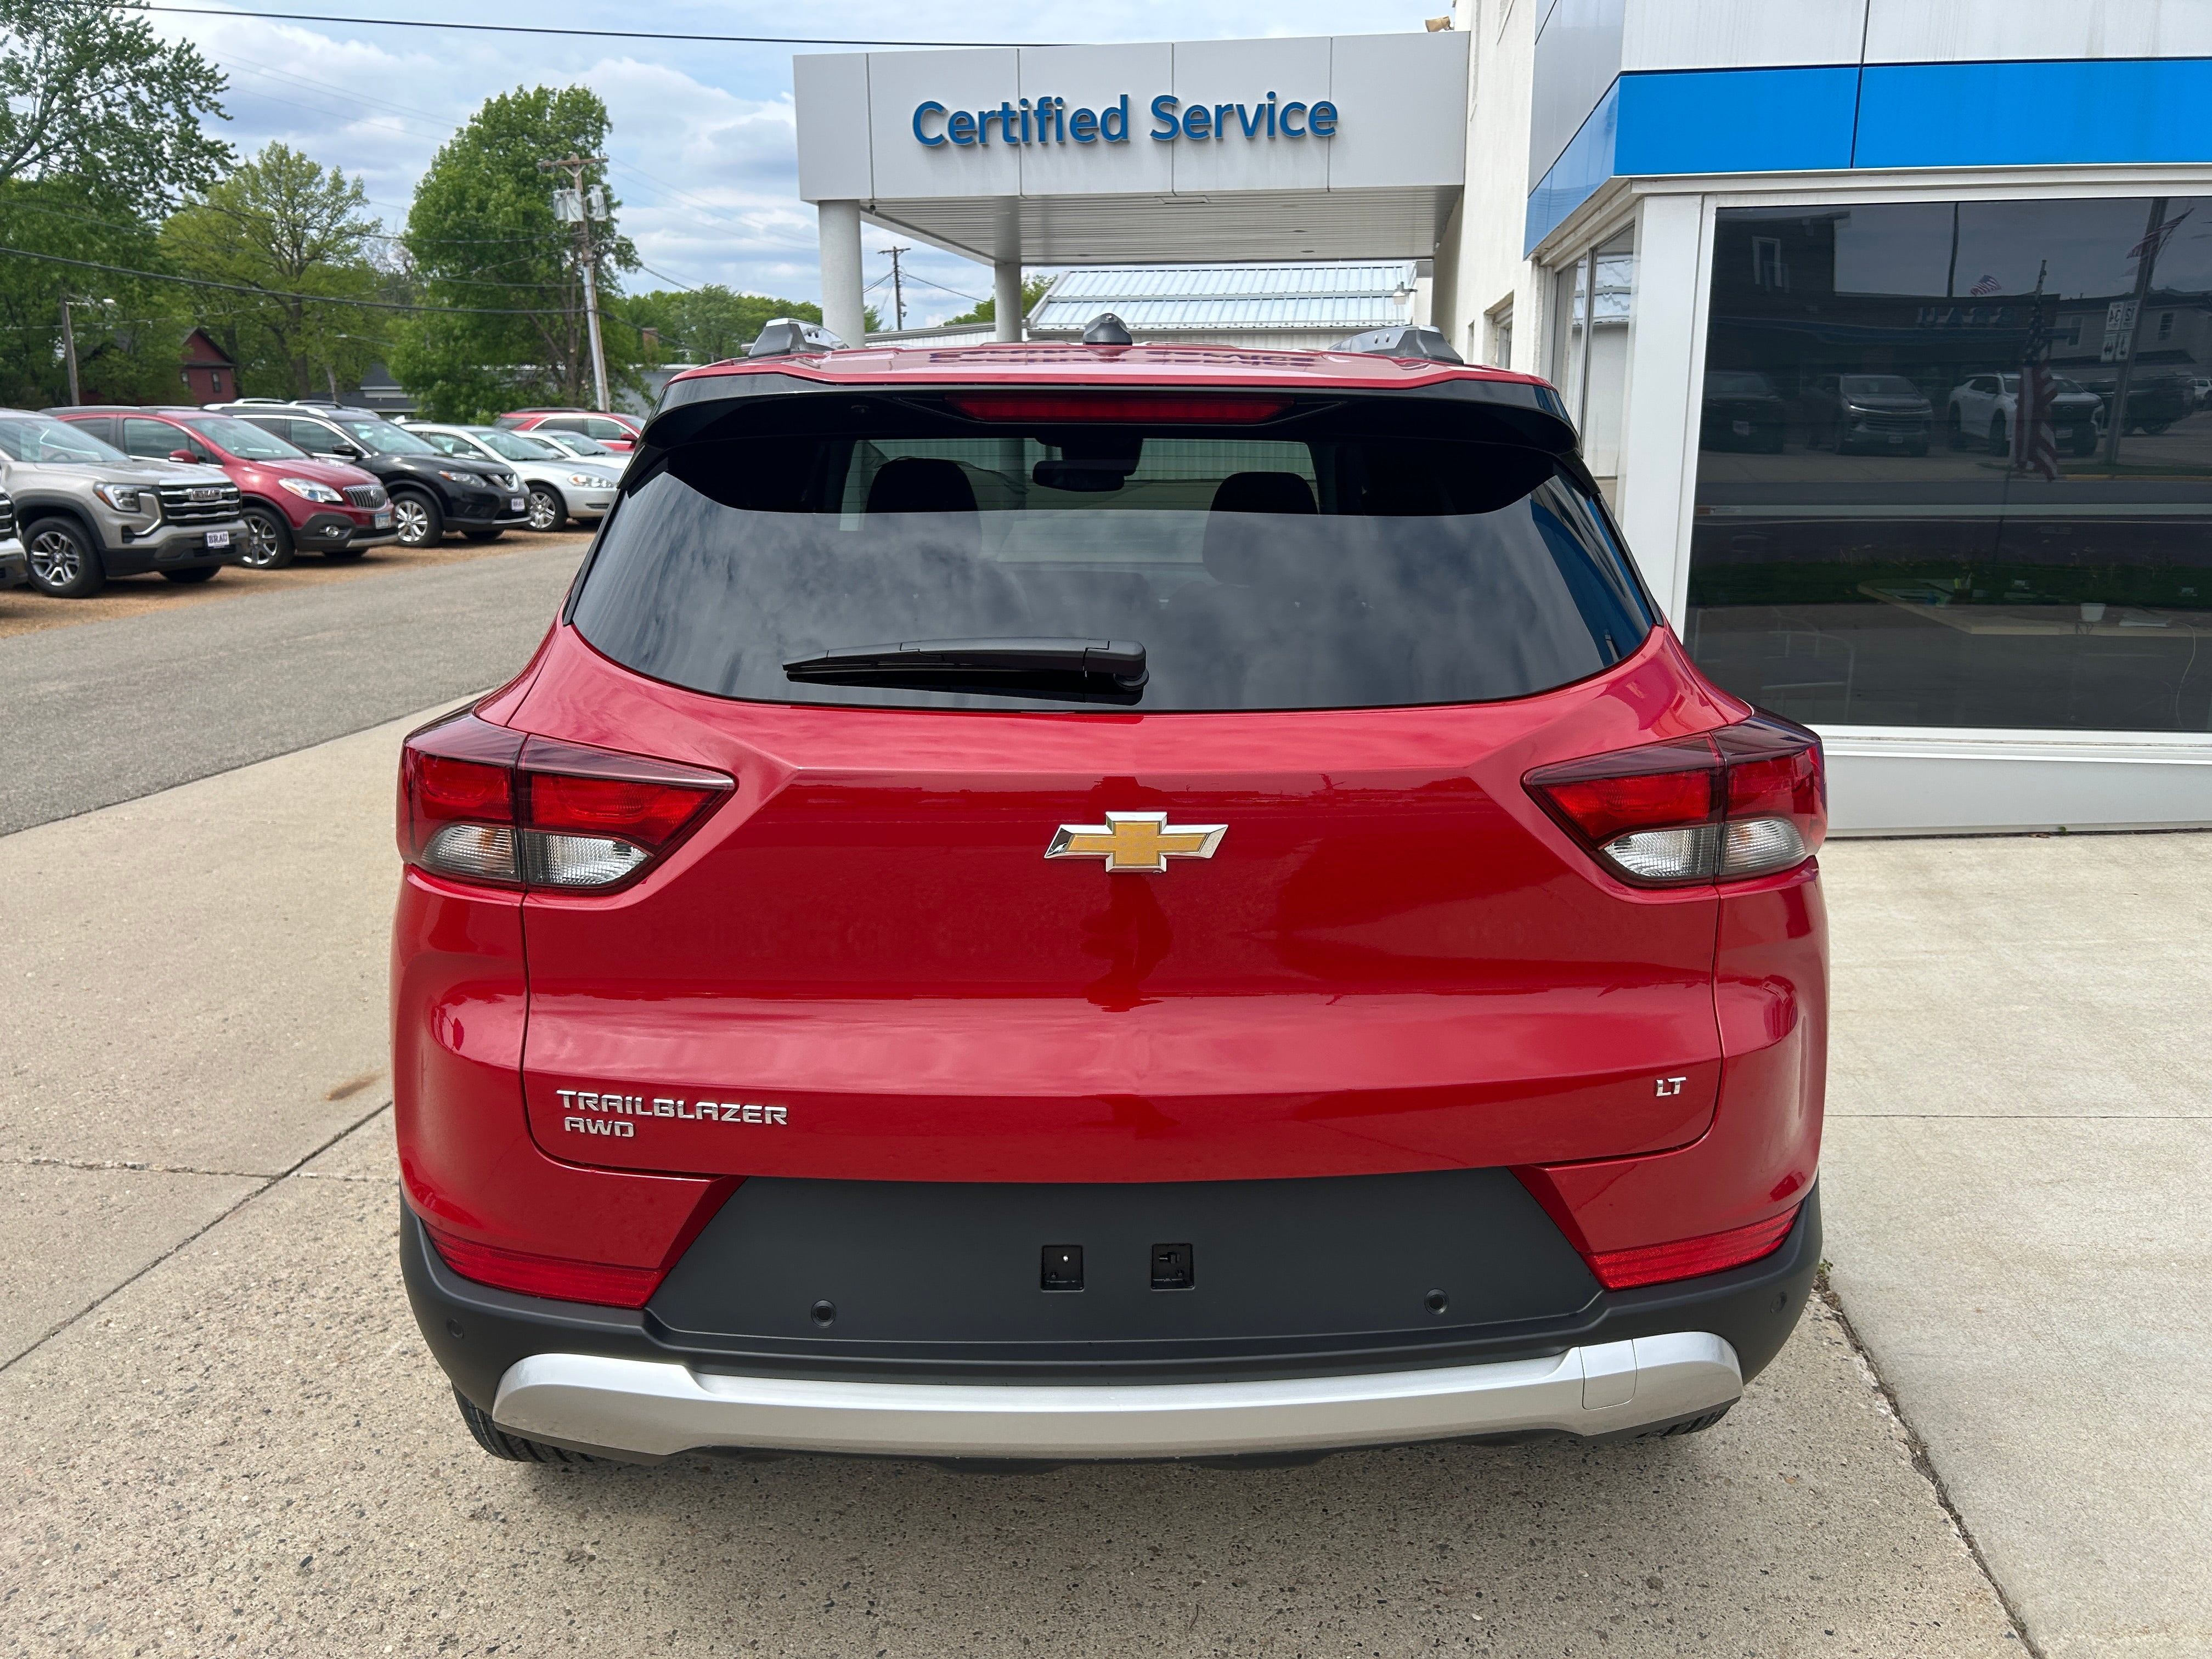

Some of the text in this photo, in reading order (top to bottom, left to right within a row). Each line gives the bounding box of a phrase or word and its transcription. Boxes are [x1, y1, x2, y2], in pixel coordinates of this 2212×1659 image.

[912, 91, 1339, 146] Certified Service
[1656, 1076, 1686, 1097] LT
[556, 1090, 787, 1125] TRAILBLAZER
[564, 1117, 634, 1138] AWD
